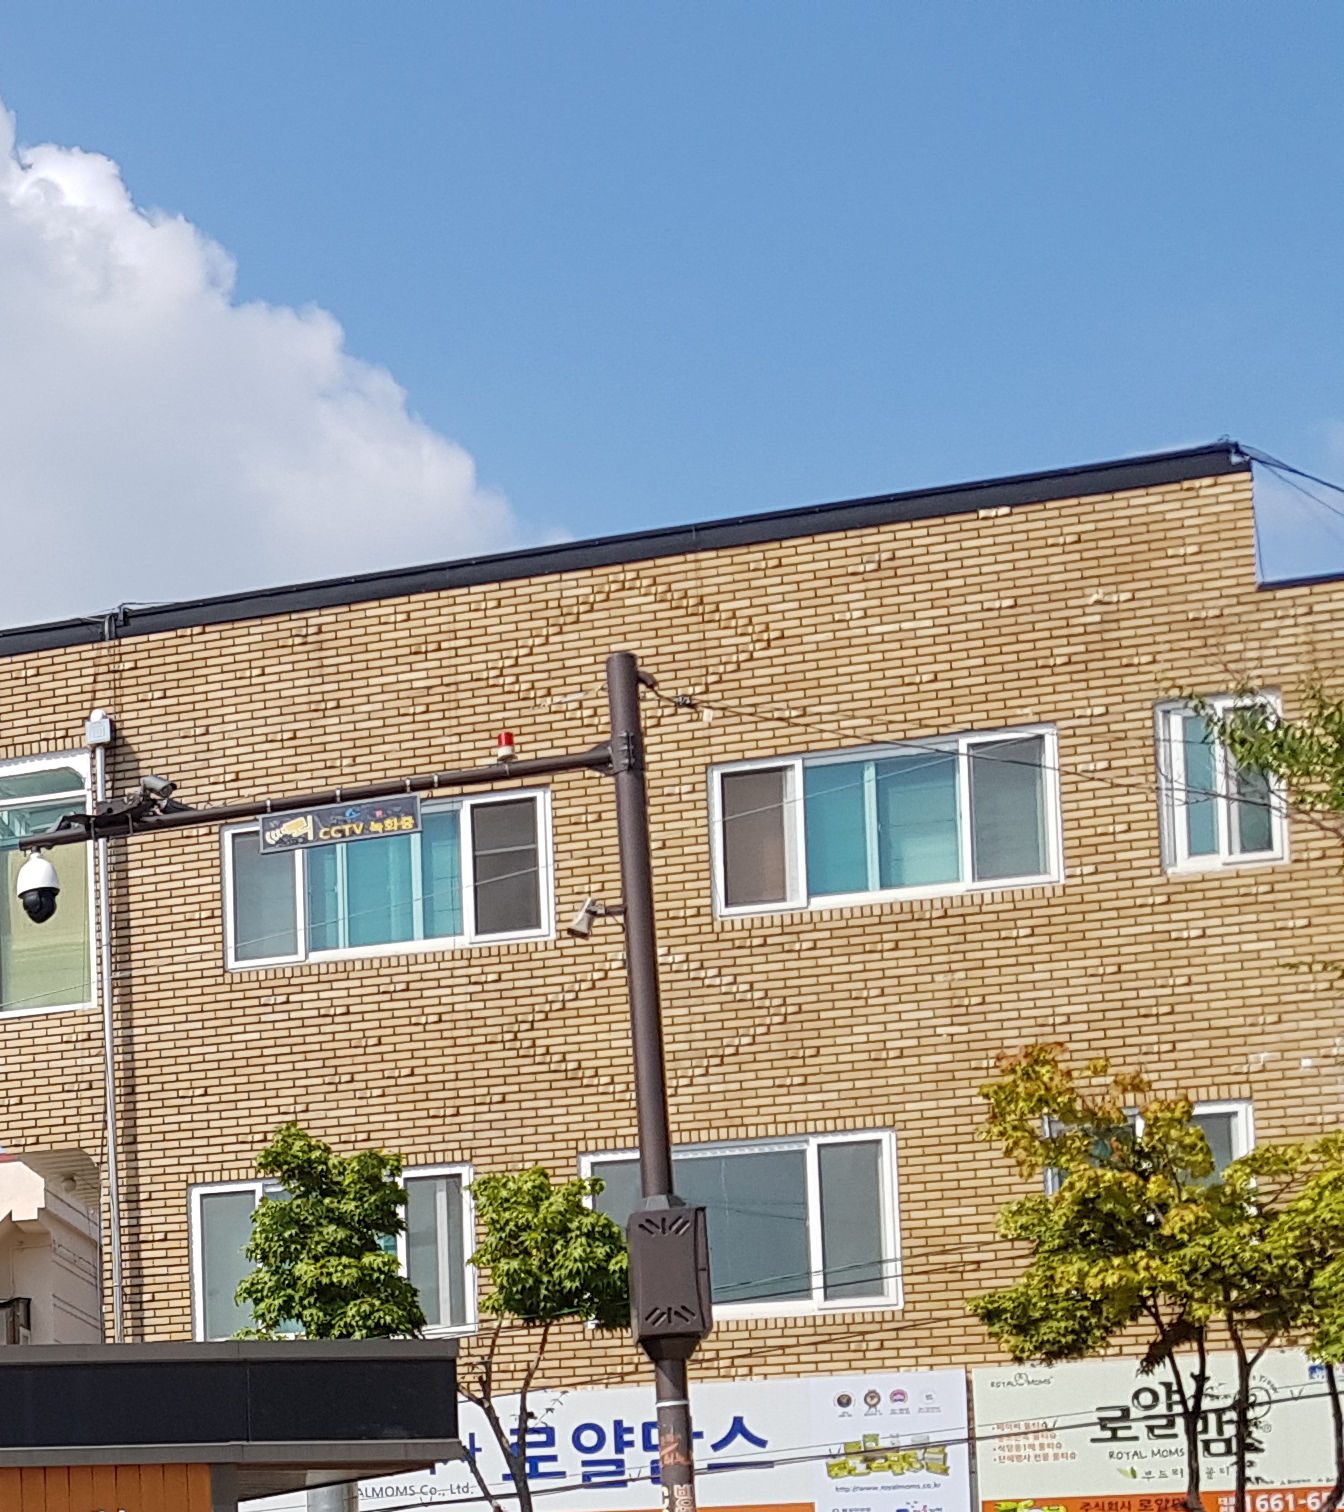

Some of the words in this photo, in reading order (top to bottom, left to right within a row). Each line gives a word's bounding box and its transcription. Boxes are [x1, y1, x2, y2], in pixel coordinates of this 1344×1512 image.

[319, 822, 364, 840] CCTV
[1109, 1450, 1147, 1460] ROYAL
[1151, 1448, 1185, 1459] MOMS
[1141, 1467, 1184, 1481] 부드러
[358, 1485, 416, 1498] ALMOMS
[420, 1484, 445, 1497] Co.,
[450, 1482, 474, 1495] Ltd.
